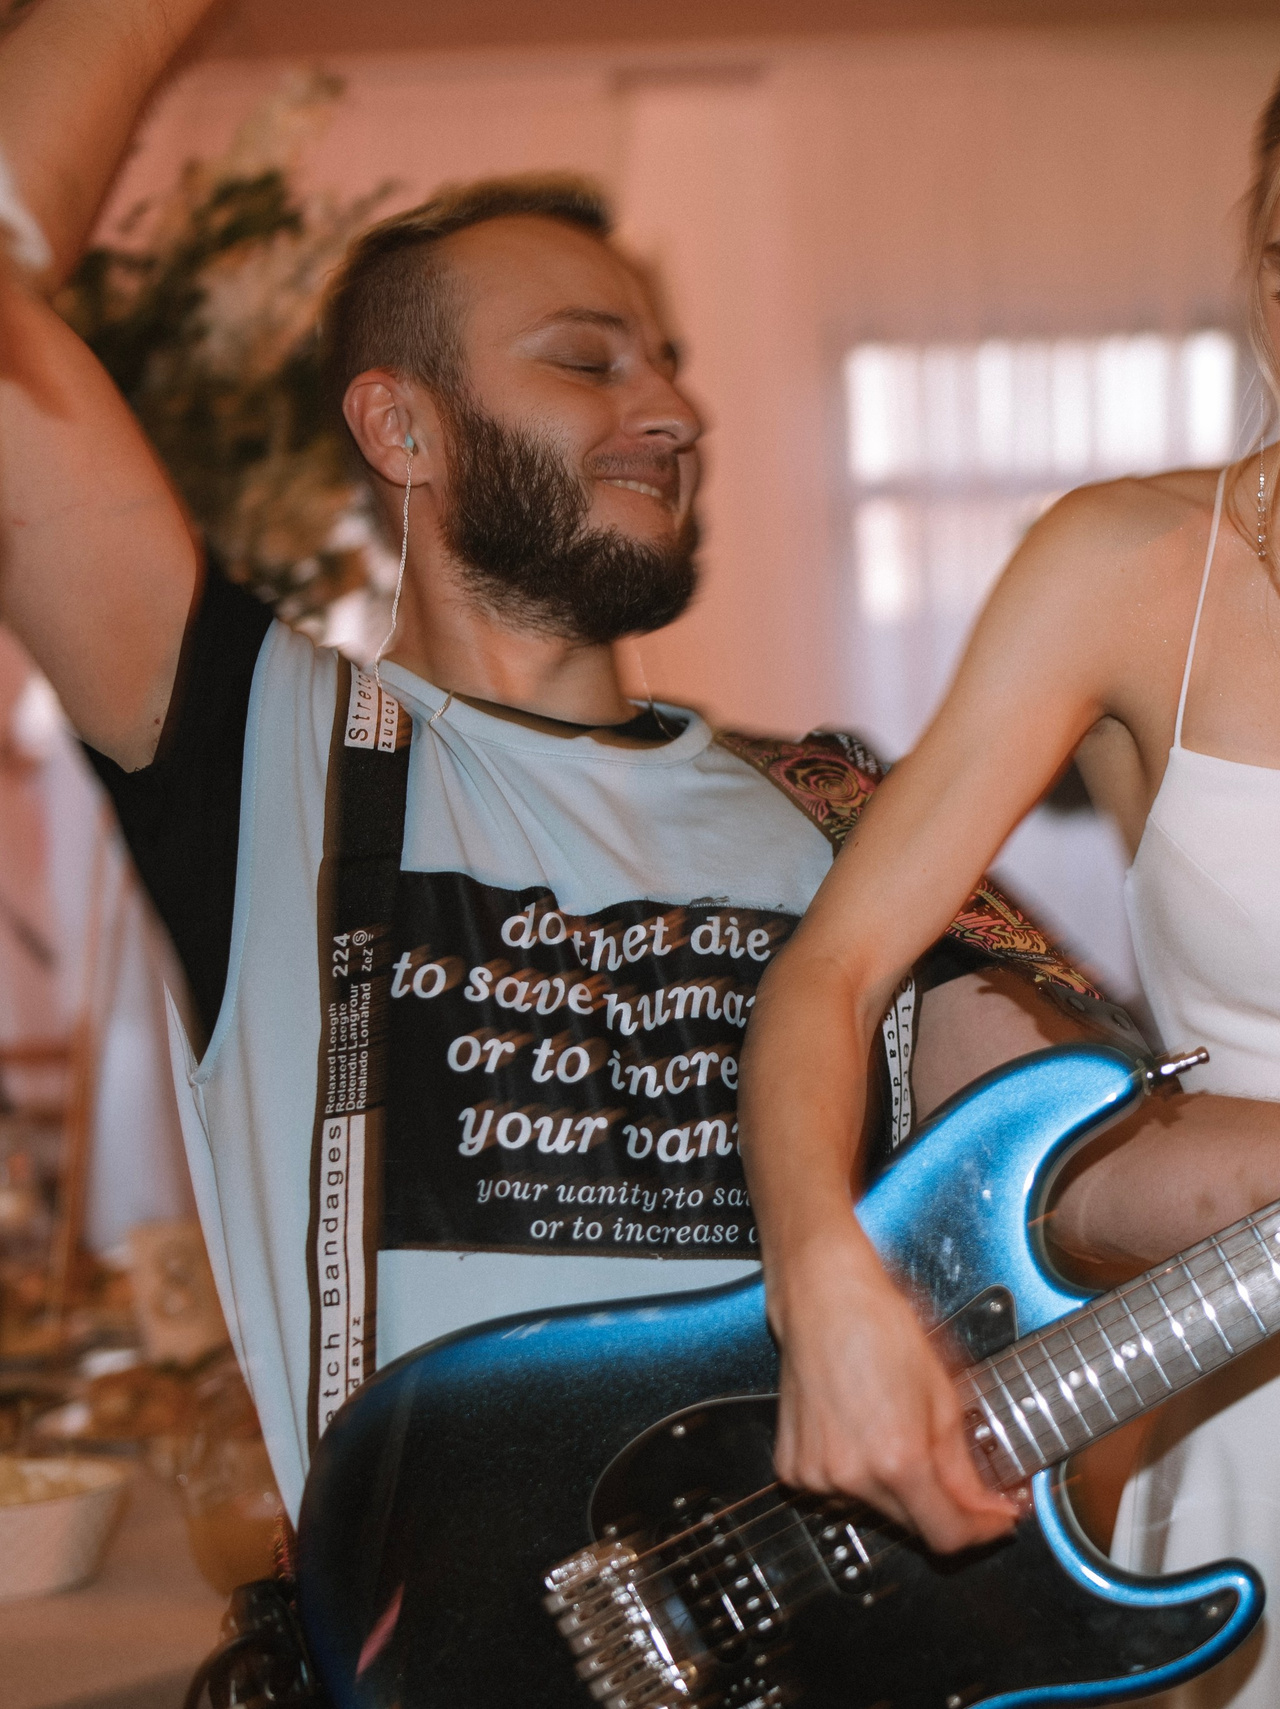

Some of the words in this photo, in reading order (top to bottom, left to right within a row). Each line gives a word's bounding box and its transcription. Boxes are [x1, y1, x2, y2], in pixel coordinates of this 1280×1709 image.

[349, 675, 371, 741] Stretc
[332, 933, 350, 978] 224
[501, 902, 567, 949] do
[691, 916, 771, 961] die
[390, 952, 447, 999] to
[464, 966, 595, 1015] save
[603, 985, 756, 1036] huma
[325, 1056, 336, 1114] Relaxed
[336, 1054, 347, 1113] Relaxed
[447, 1036, 515, 1073] or
[531, 1038, 590, 1083] to
[607, 1050, 738, 1098] incre
[458, 1107, 608, 1156] your
[323, 1125, 343, 1307] Bandages
[477, 1179, 548, 1204] your
[530, 1219, 563, 1240] or
[572, 1217, 603, 1240] to
[612, 1217, 739, 1244] increase
